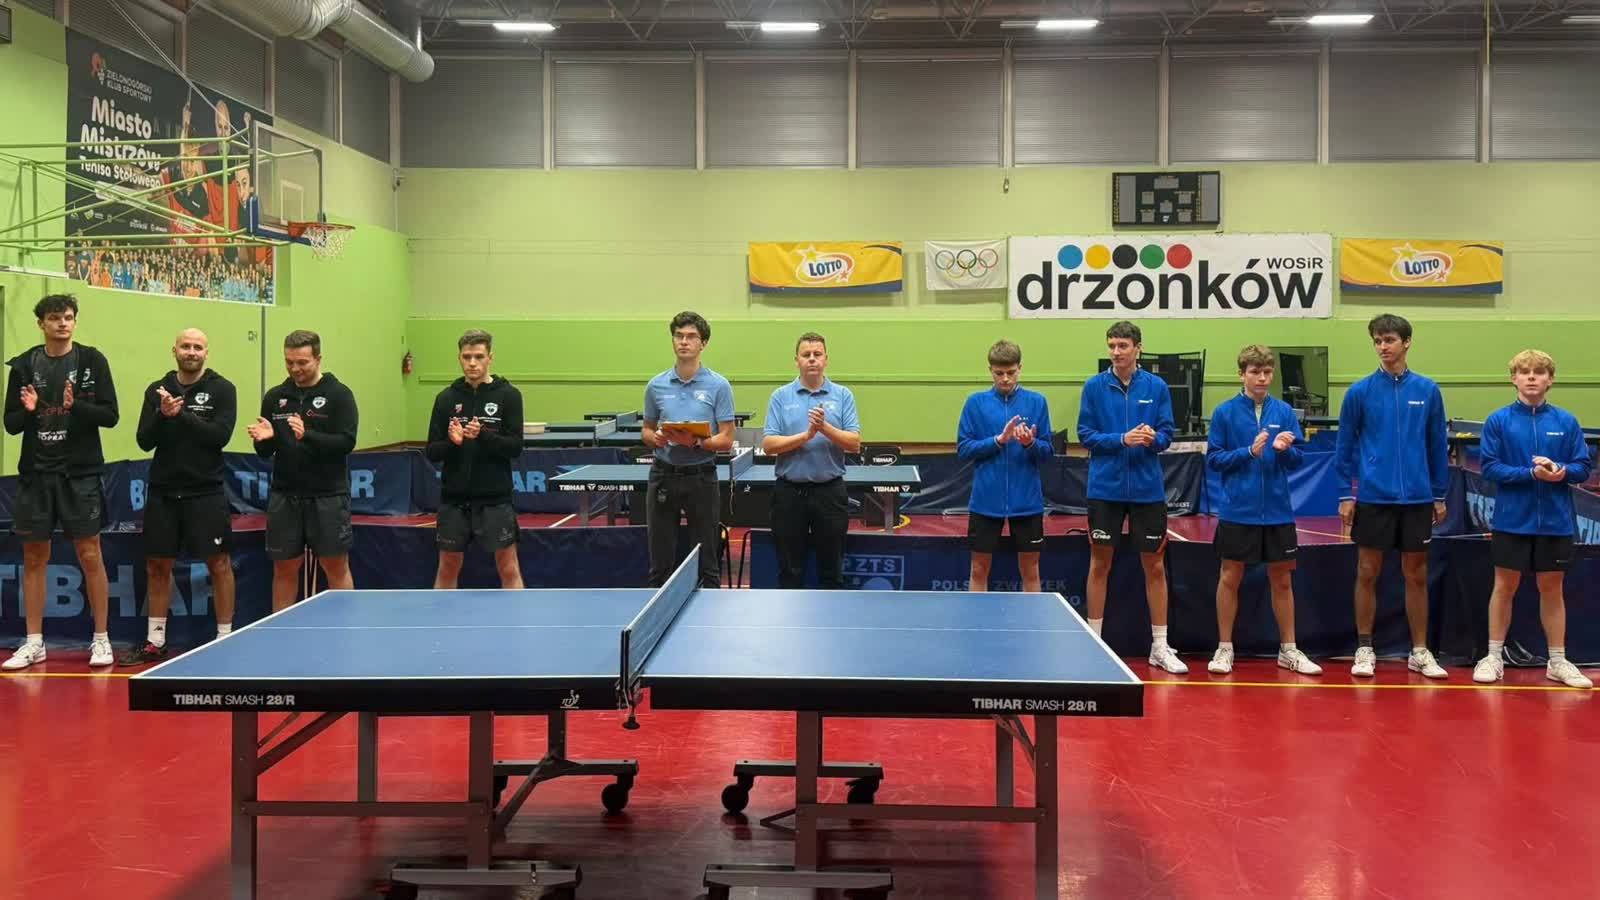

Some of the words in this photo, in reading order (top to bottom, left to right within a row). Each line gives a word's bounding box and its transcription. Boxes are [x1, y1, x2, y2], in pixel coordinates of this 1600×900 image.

[107, 81, 121, 92] KLUB
[92, 96, 152, 139] Miasto
[80, 124, 161, 171] Mistrzów
[808, 259, 842, 276] LOTTO
[1267, 257, 1323, 269] WOSiR
[1404, 258, 1439, 275] LOTTO
[1017, 259, 1323, 310] drzonków
[173, 694, 222, 705] TIBHAR
[225, 695, 264, 706] SMASH
[266, 695, 295, 706] 28/R
[972, 698, 1022, 710] TIBHAR
[1025, 700, 1065, 711] SMASH
[1067, 700, 1097, 711] 28/R
